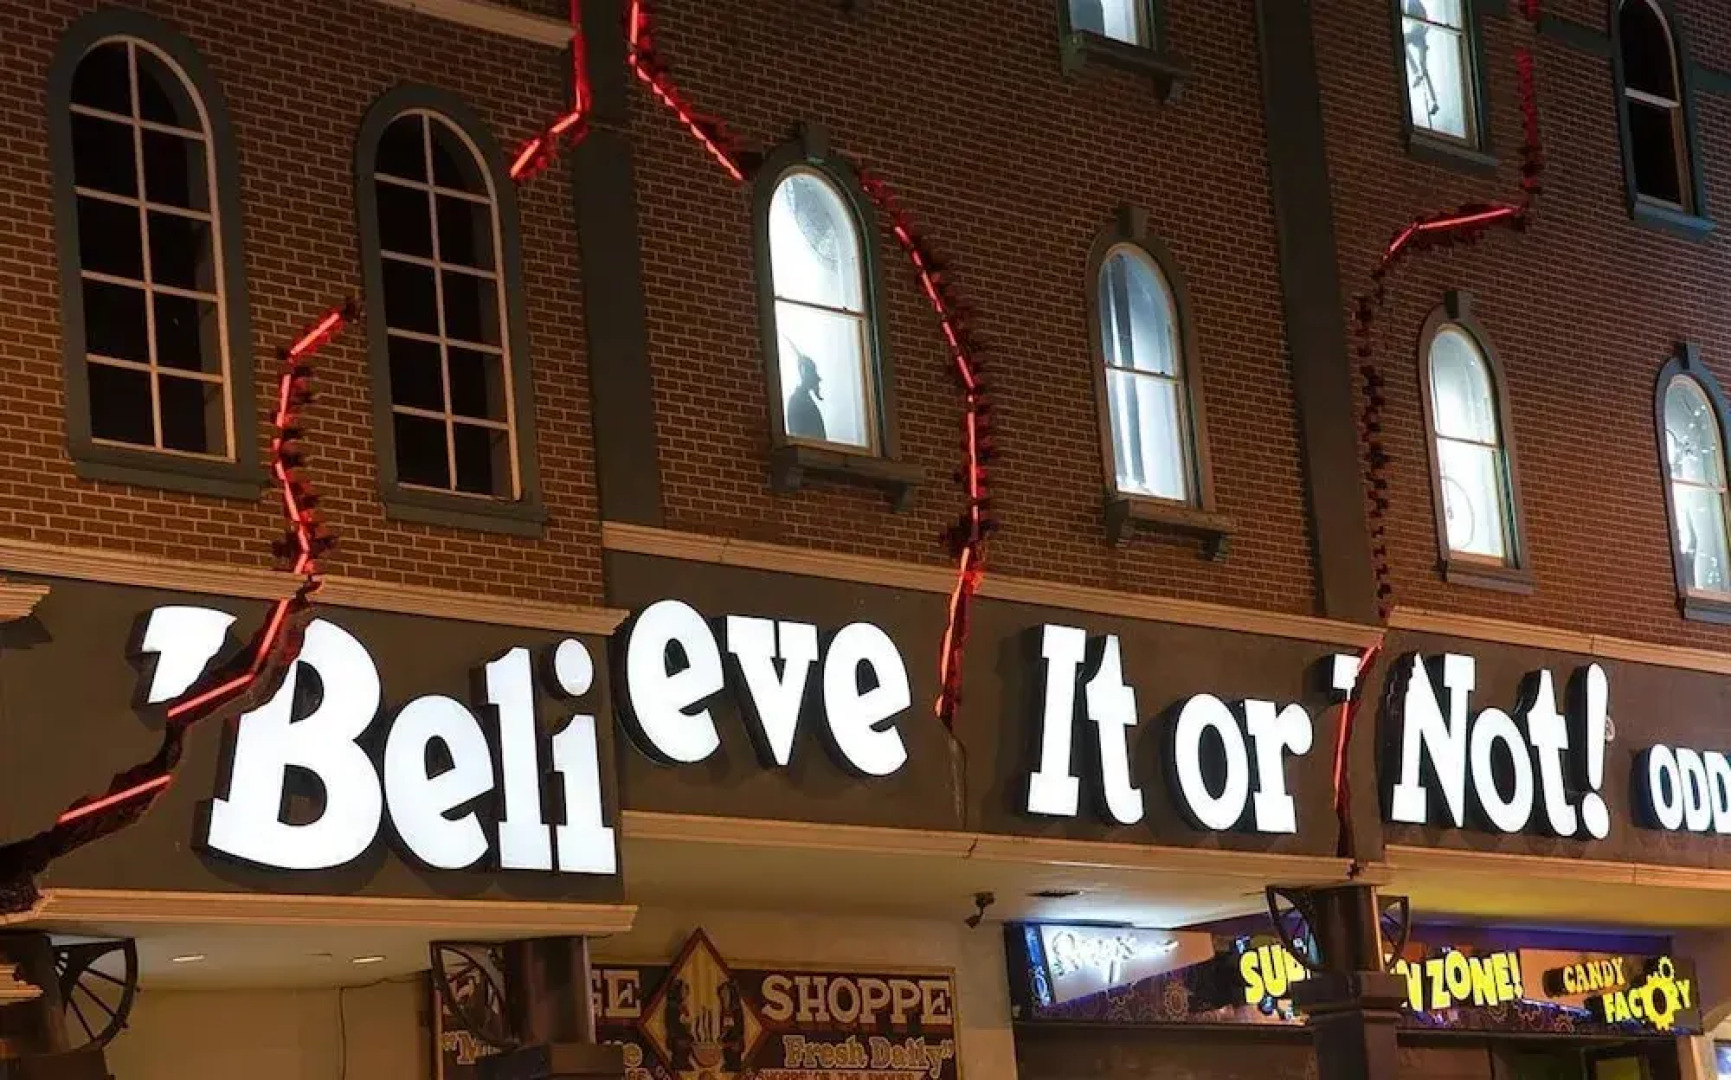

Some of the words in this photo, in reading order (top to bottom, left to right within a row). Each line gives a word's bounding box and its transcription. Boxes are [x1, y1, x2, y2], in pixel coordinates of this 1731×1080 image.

[1027, 624, 1143, 824] It
[1175, 694, 1313, 833] or
[1333, 653, 1609, 839] Not!
[761, 974, 952, 1025] SHOPPE
[1425, 950, 1524, 1009] ZONE!
[1562, 957, 1626, 993] CANDY
[1602, 973, 1691, 1031] FACTORY
[783, 1034, 868, 1069] Fresh
